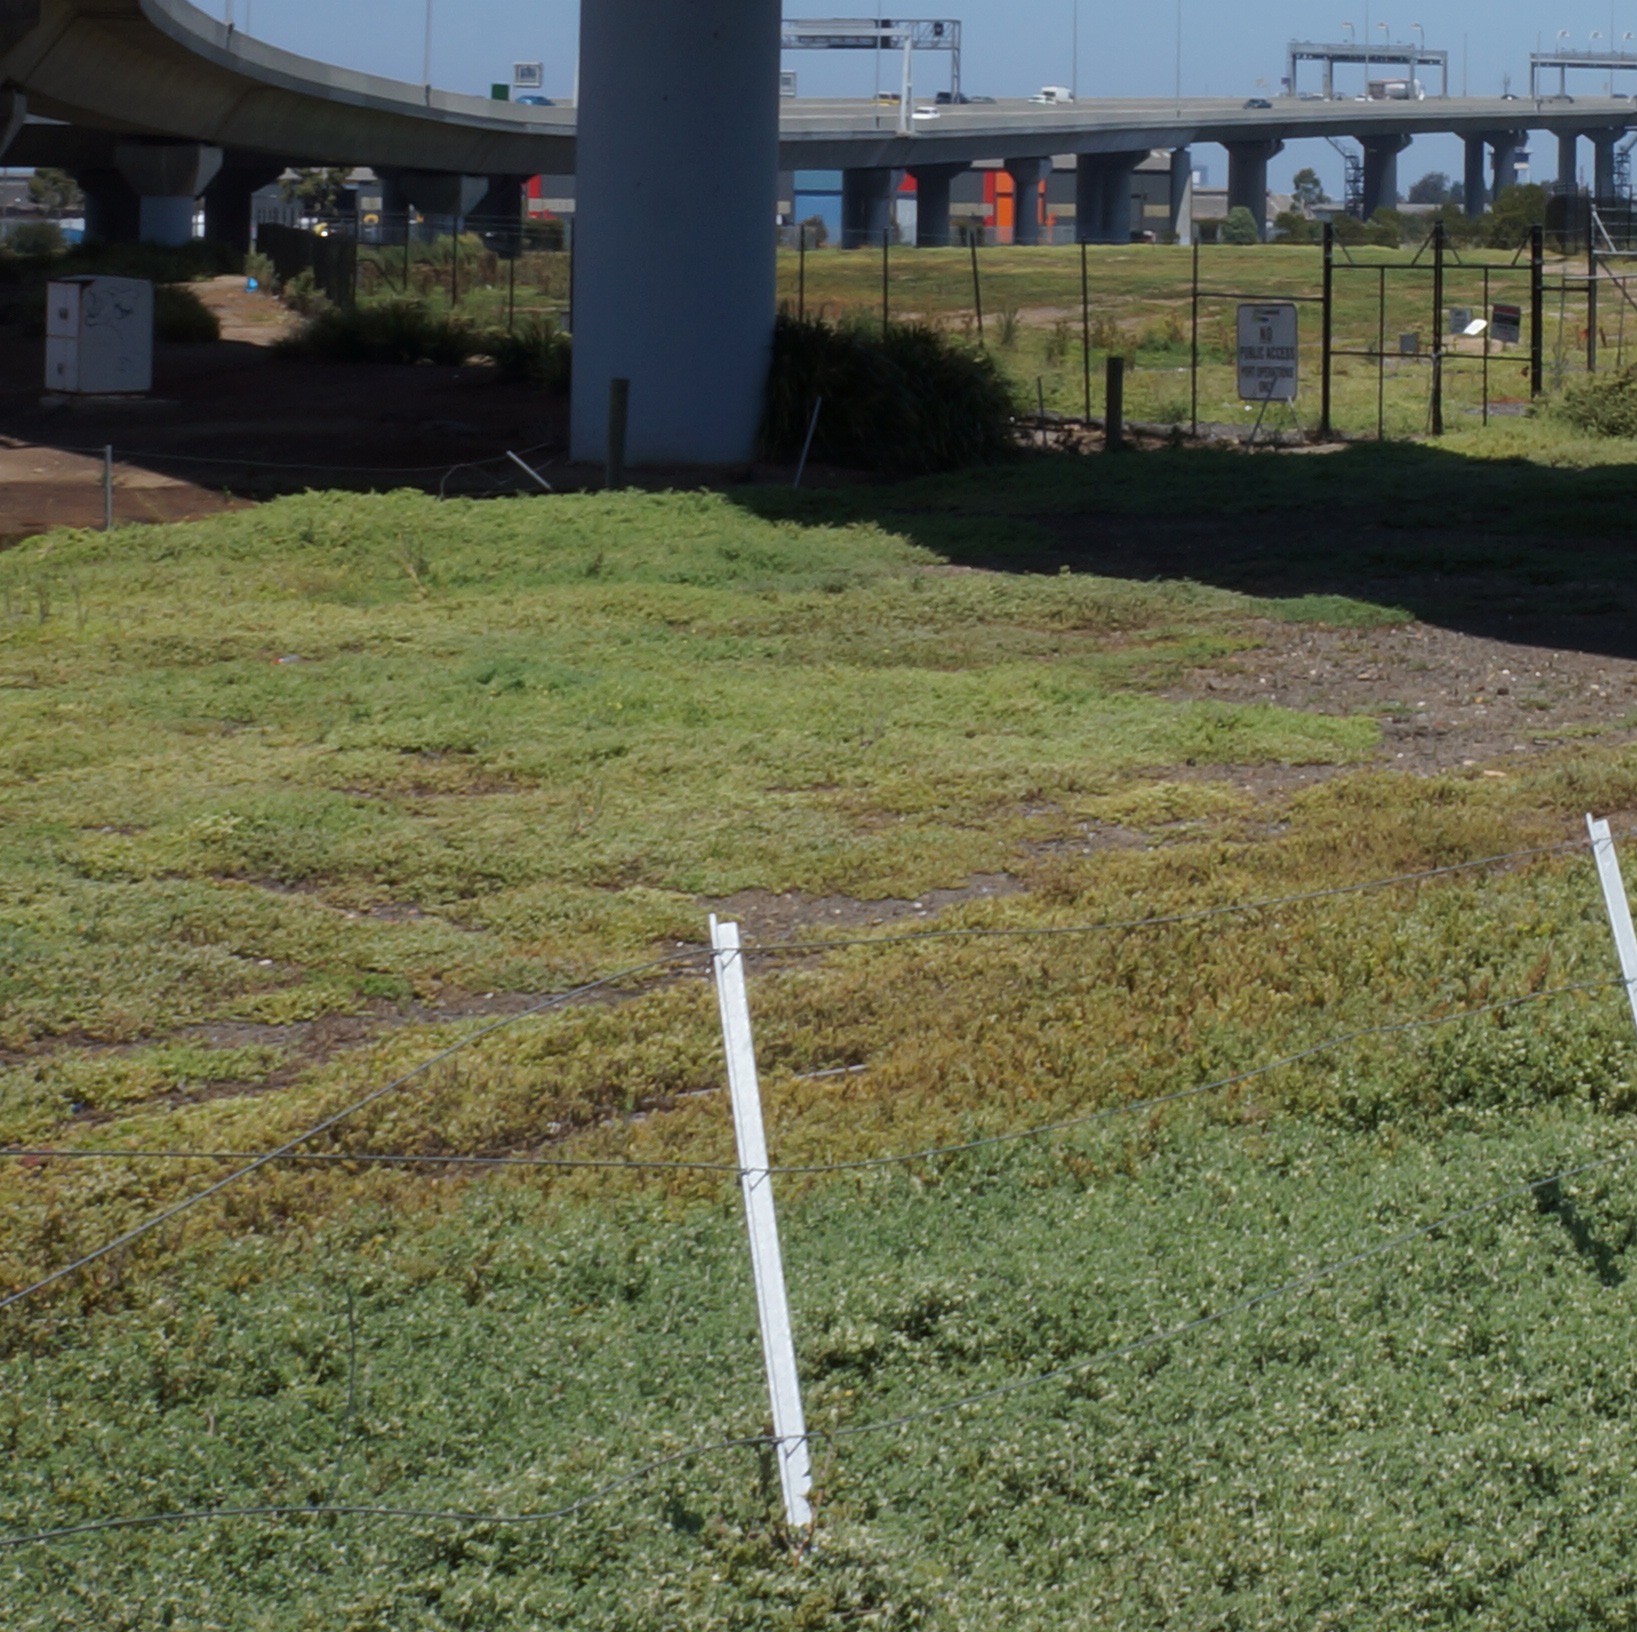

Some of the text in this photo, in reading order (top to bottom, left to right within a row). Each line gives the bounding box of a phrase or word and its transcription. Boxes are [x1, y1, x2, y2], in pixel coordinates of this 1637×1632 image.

[1260, 325, 1273, 343] NO
[1239, 346, 1296, 360] PUBLIC ACCESS
